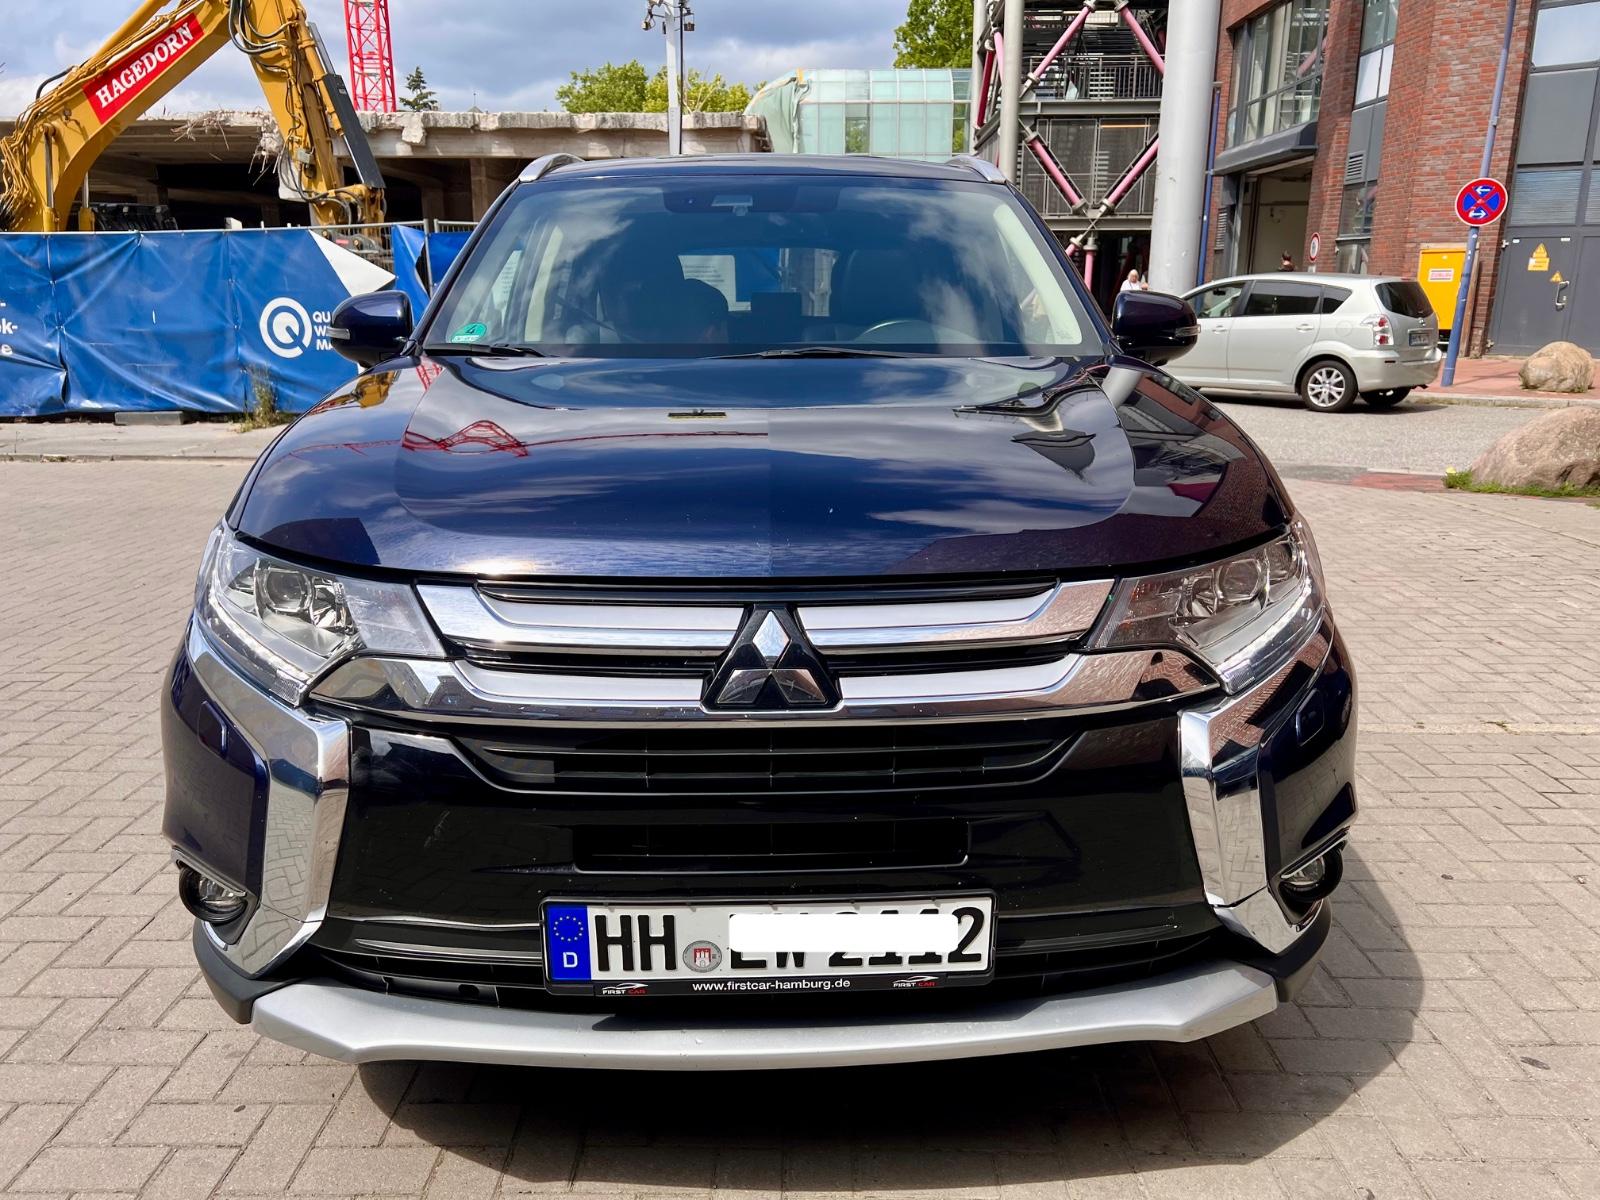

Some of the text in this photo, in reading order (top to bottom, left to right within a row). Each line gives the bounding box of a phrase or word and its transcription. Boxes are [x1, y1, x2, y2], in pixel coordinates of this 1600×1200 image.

[95, 22, 194, 109] HAGEDORN
[313, 311, 331, 323] QU
[0, 318, 18, 335] k-
[594, 914, 677, 972] HH
[562, 951, 579, 968] D
[692, 979, 851, 992] www.firstcar-hamburg.de
